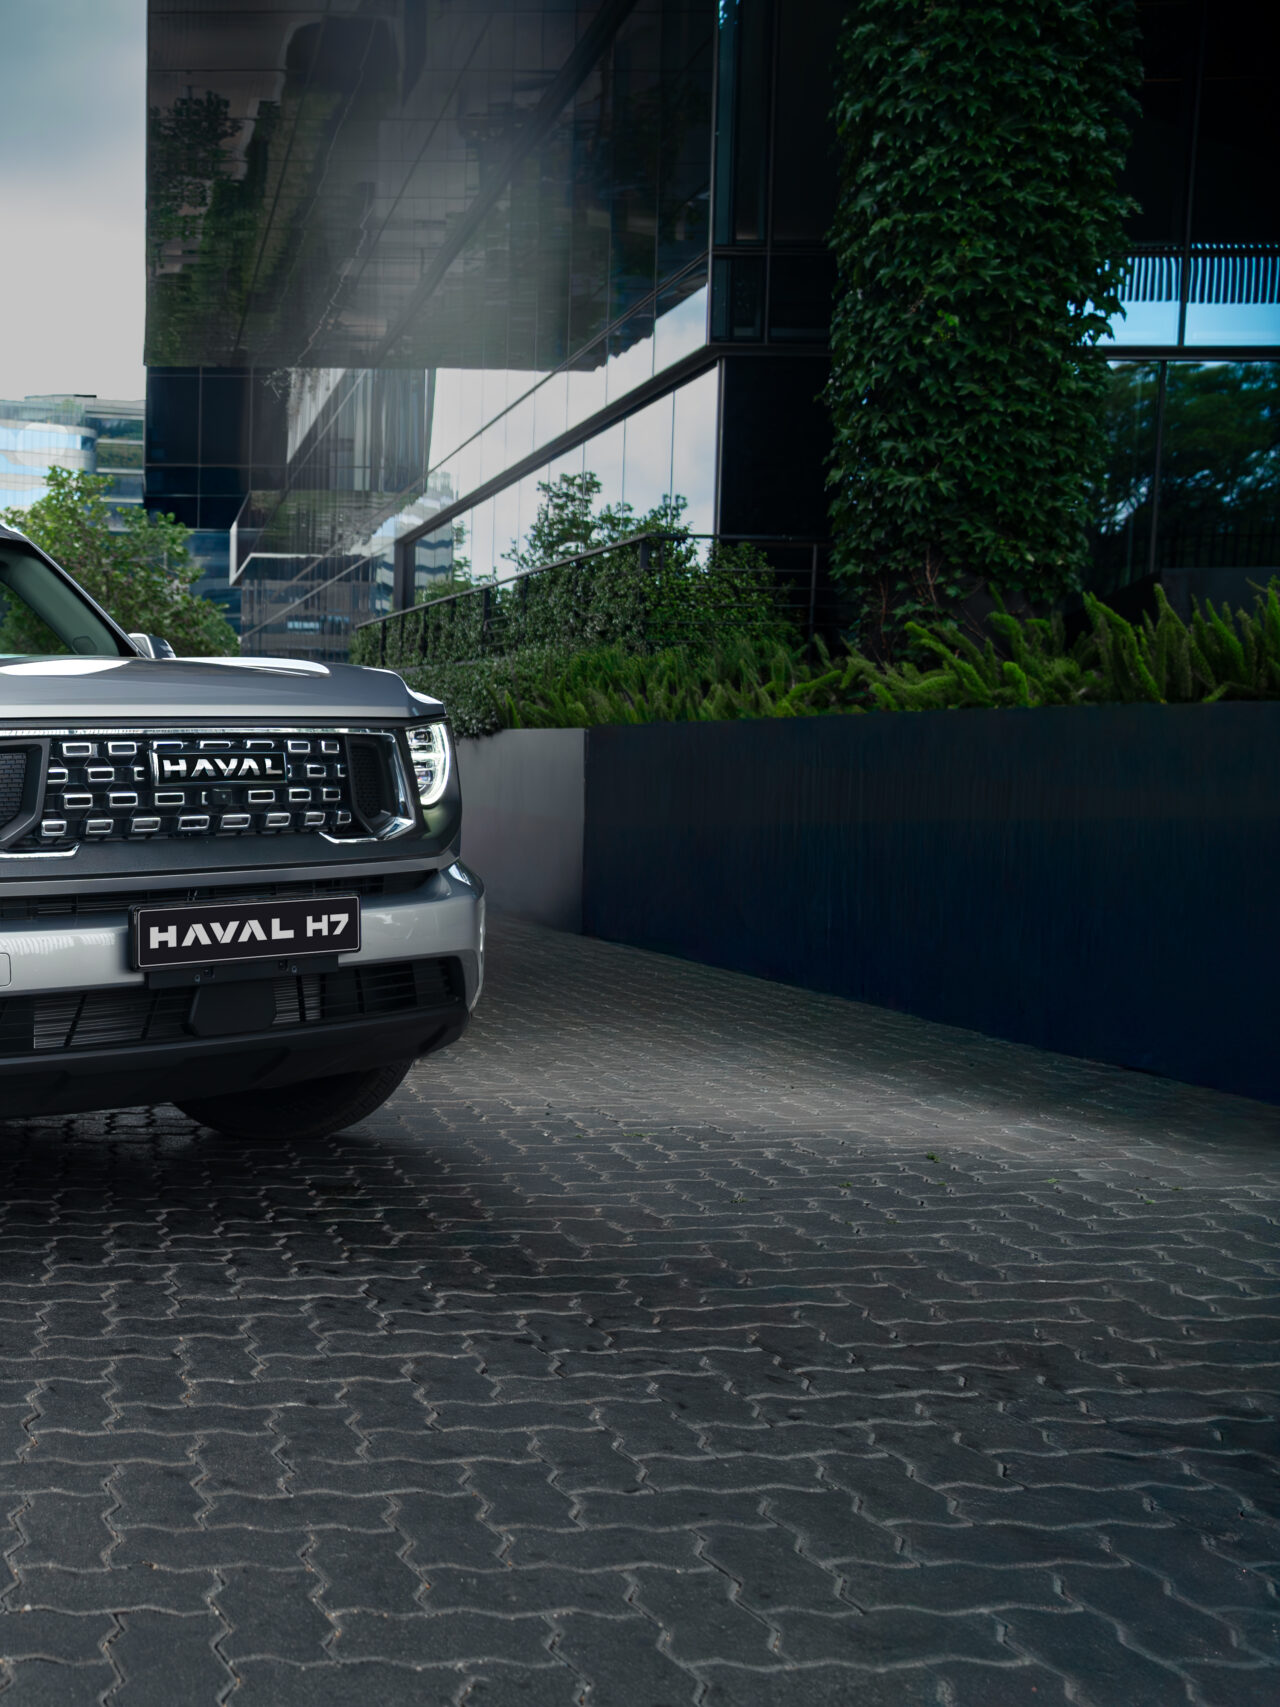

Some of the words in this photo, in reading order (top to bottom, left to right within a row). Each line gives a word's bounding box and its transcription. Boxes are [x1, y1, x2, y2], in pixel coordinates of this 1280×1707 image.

[163, 758, 282, 777] HAVAL
[149, 918, 294, 949] HAVAL
[306, 913, 349, 937] H7
